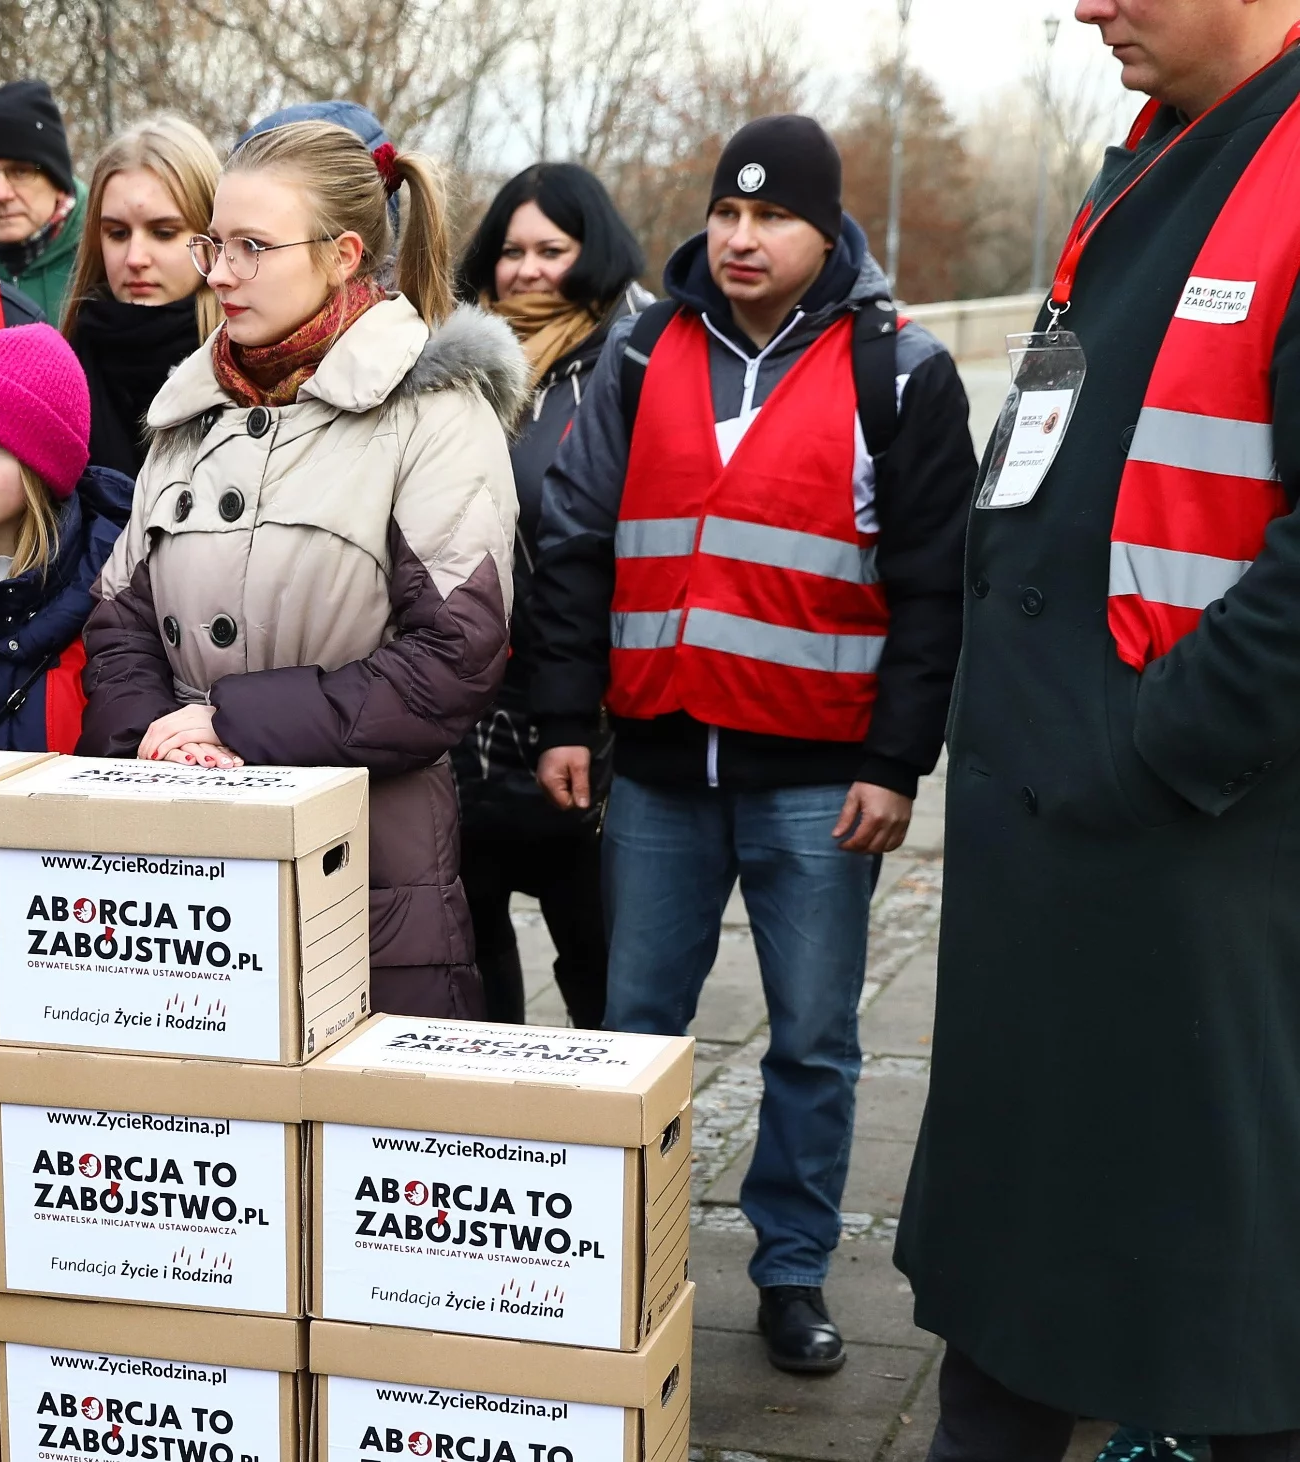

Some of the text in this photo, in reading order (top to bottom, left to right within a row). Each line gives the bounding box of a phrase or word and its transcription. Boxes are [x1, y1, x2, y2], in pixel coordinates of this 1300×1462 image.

[1188, 286, 1246, 300] ABORCJA TO
[41, 855, 225, 880] www.ZycieRodzina.pl
[26, 895, 231, 932] ABORCJA TO
[28, 926, 263, 971] ZABÓJSTWO.PL
[27, 961, 231, 981] OBYWATELSKA INICJATYWA USTAWODAWCZA
[44, 1006, 226, 1031] Fundacja Życie i Rodzina
[395, 1033, 609, 1055] ABORCJA TO
[47, 1111, 230, 1137] www.ZycieRodzina.pl
[372, 1137, 567, 1167] www.ZycieRodzina.pl
[33, 1150, 237, 1187] ABORCJA TO
[34, 1181, 269, 1225] ZABÓJSTWO.PL
[355, 1175, 572, 1219] ABORCJA TO
[34, 1212, 237, 1235] OBYWATELSKA INICJATYWA USTAWODAWCZA
[355, 1210, 605, 1259] ZABÓJSTWO.PL
[355, 1241, 571, 1268] OBYWATELSKA INICJATYWA USTAWODAWCZA
[51, 1257, 232, 1284] Fundacja Życie i Rodzina
[371, 1286, 564, 1318] Fundacja Życie i Rodzina
[51, 1355, 227, 1386] www.ZycieRodzina.pl
[36, 1392, 233, 1434] ABORCJA TO
[376, 1388, 568, 1421] www.ZycieRodzina.pl
[39, 1424, 259, 1462] ZABÓJSTWO
[360, 1426, 573, 1462] ABORCJA TO
